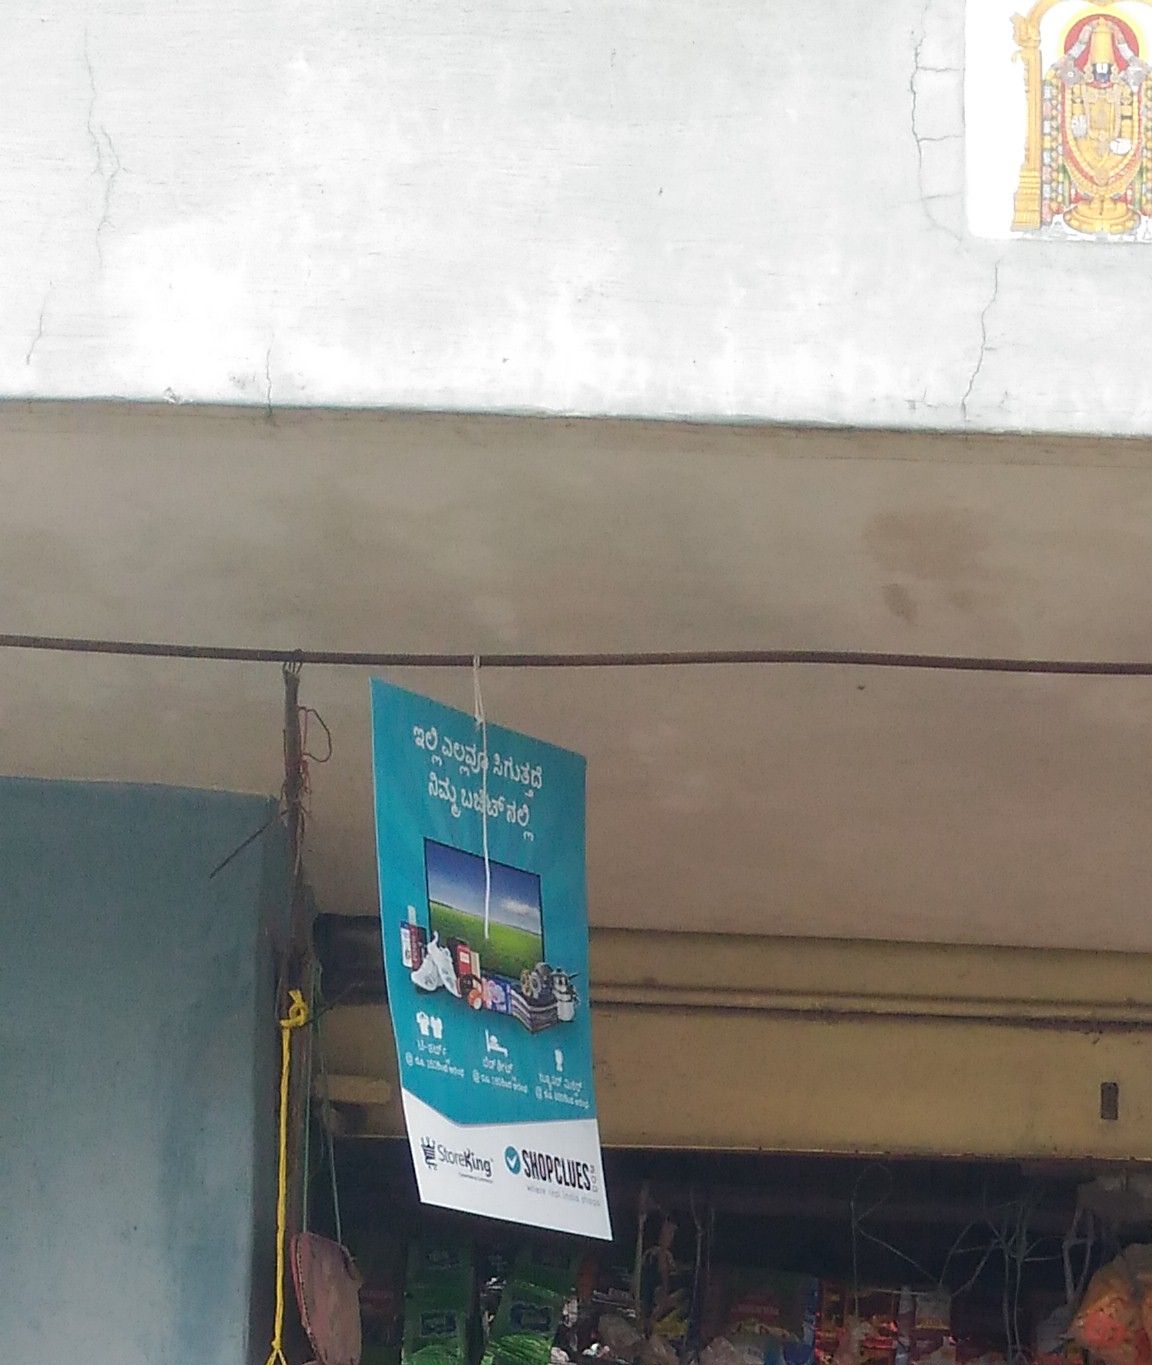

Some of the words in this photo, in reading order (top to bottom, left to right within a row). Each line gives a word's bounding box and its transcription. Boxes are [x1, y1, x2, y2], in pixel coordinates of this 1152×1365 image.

[413, 725, 442, 767] ಇಲ್ಲಿ
[437, 1144, 492, 1177] StoreKing
[521, 1149, 591, 1191] SHOPCLUES
